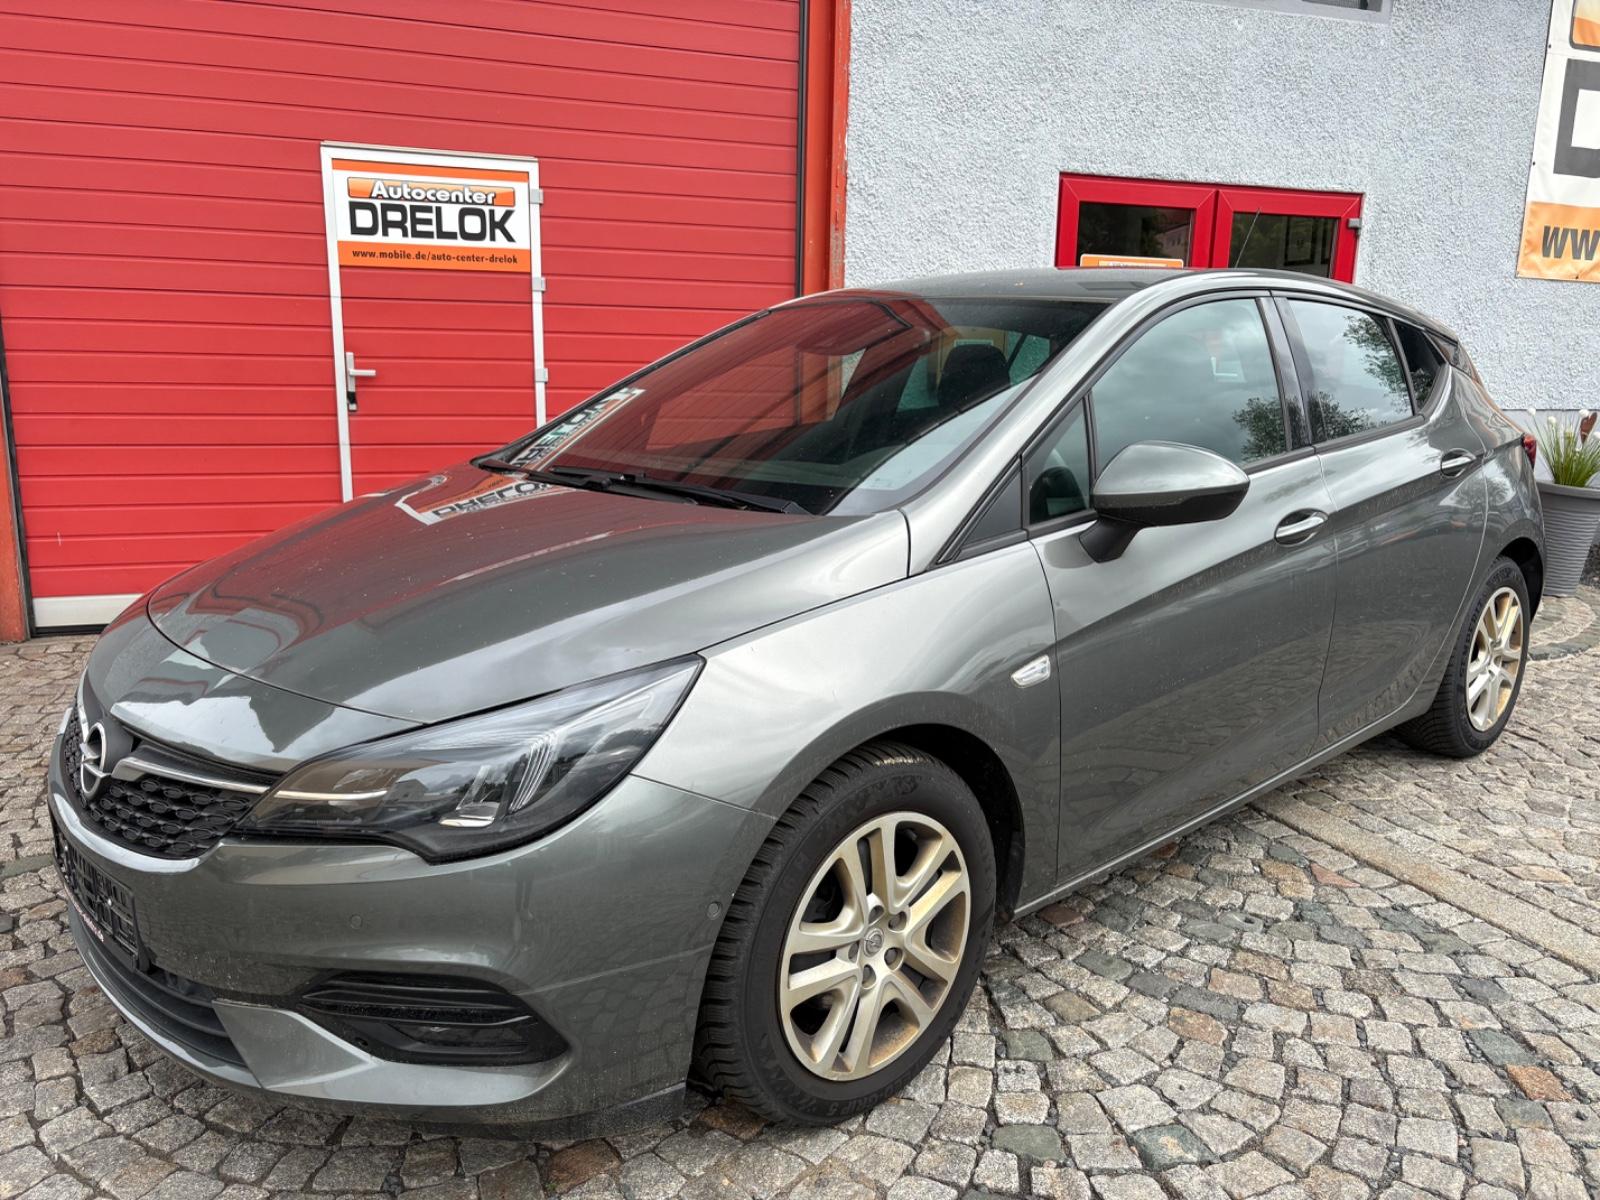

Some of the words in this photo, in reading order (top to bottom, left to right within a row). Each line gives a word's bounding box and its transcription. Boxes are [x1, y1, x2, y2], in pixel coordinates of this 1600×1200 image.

[370, 180, 496, 205] Autocenter
[348, 200, 516, 243] DRELOK
[352, 249, 518, 264] www.mobile.de/auto-center-drelok
